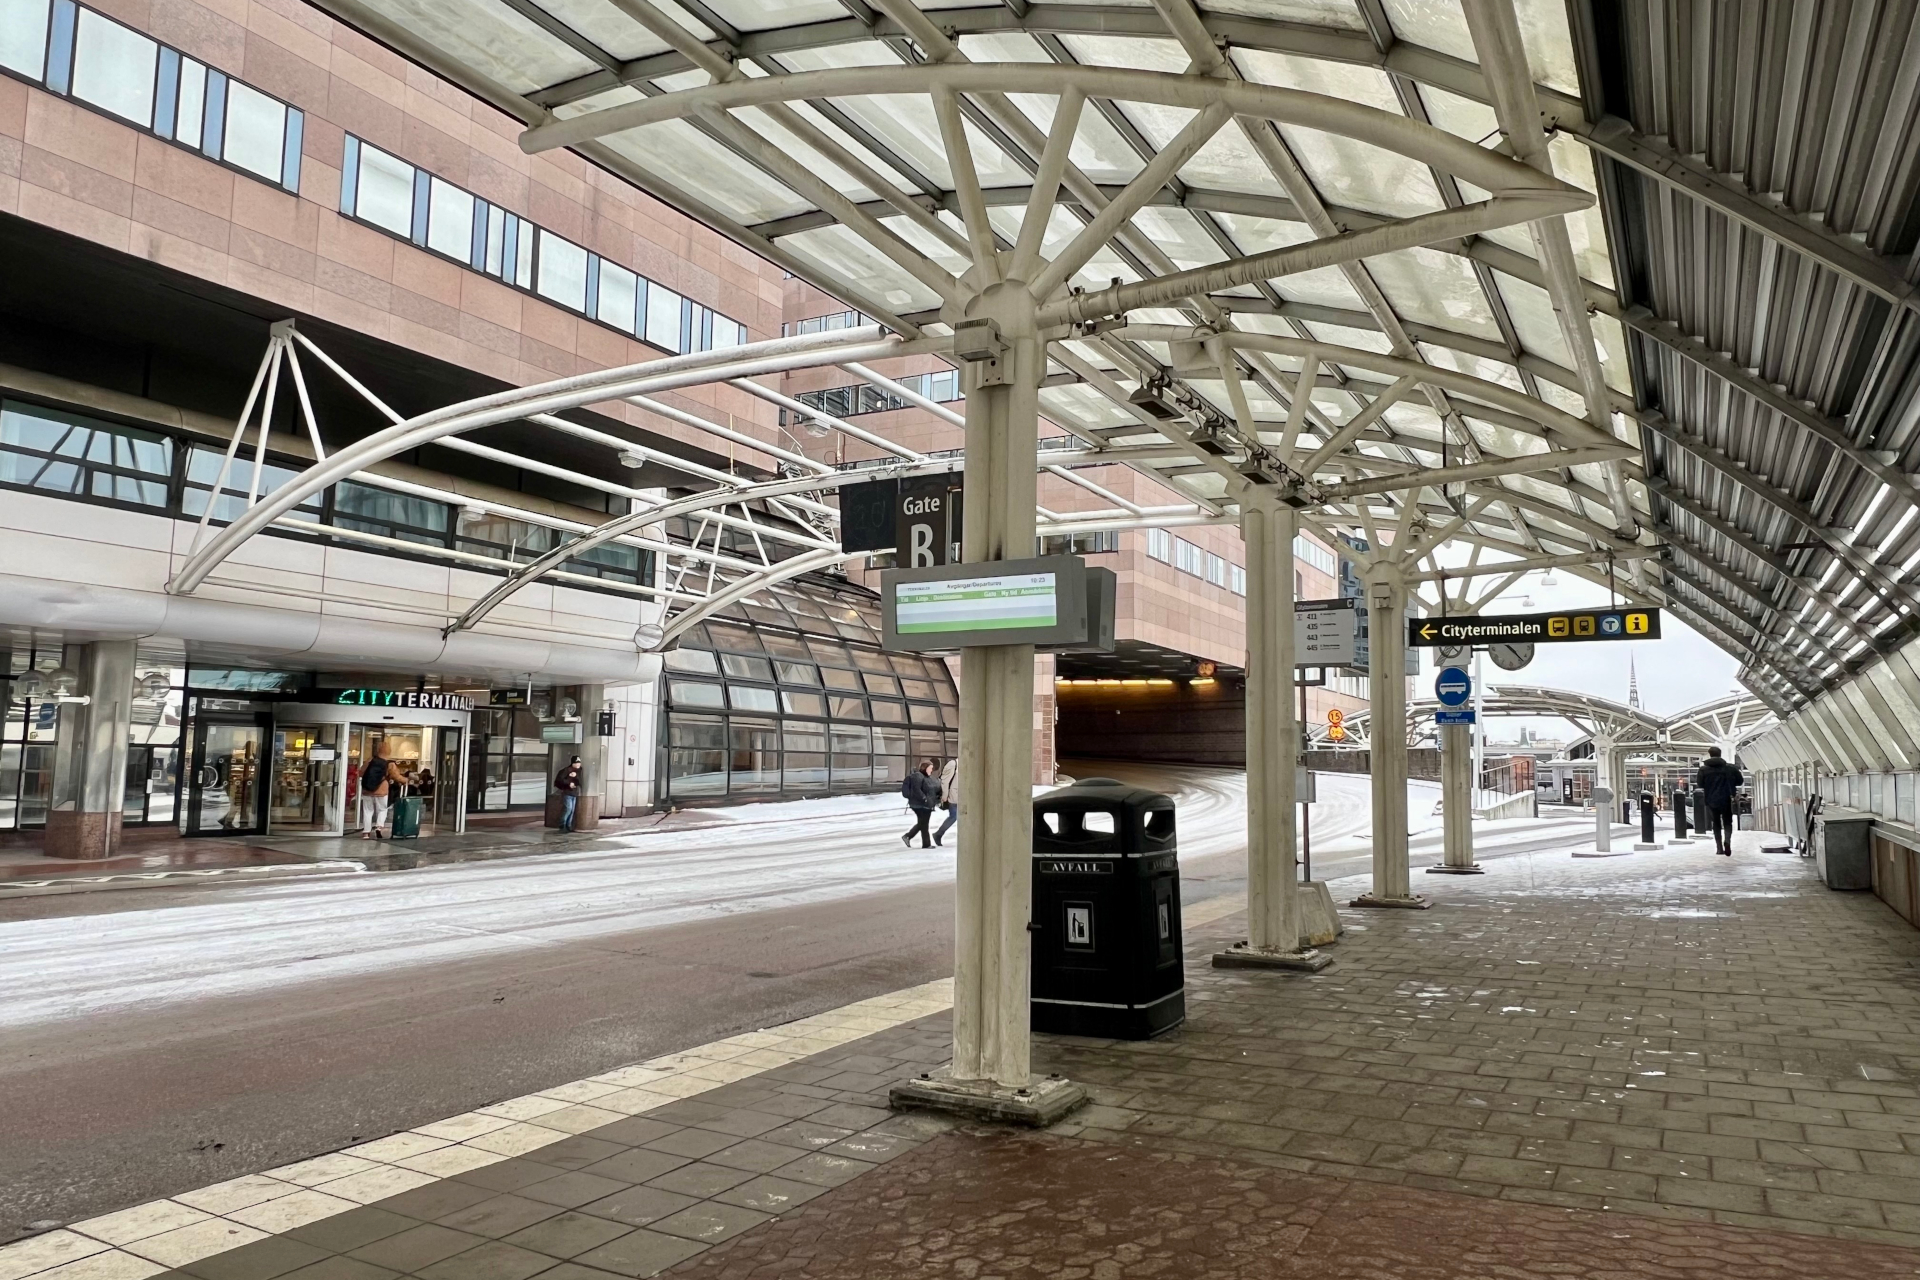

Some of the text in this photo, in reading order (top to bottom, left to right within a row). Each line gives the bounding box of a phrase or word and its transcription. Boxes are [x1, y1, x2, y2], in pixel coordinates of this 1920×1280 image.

[903, 497, 940, 515] Gate
[1441, 623, 1541, 638] Cityterminalen
[1331, 712, 1341, 720] 15
